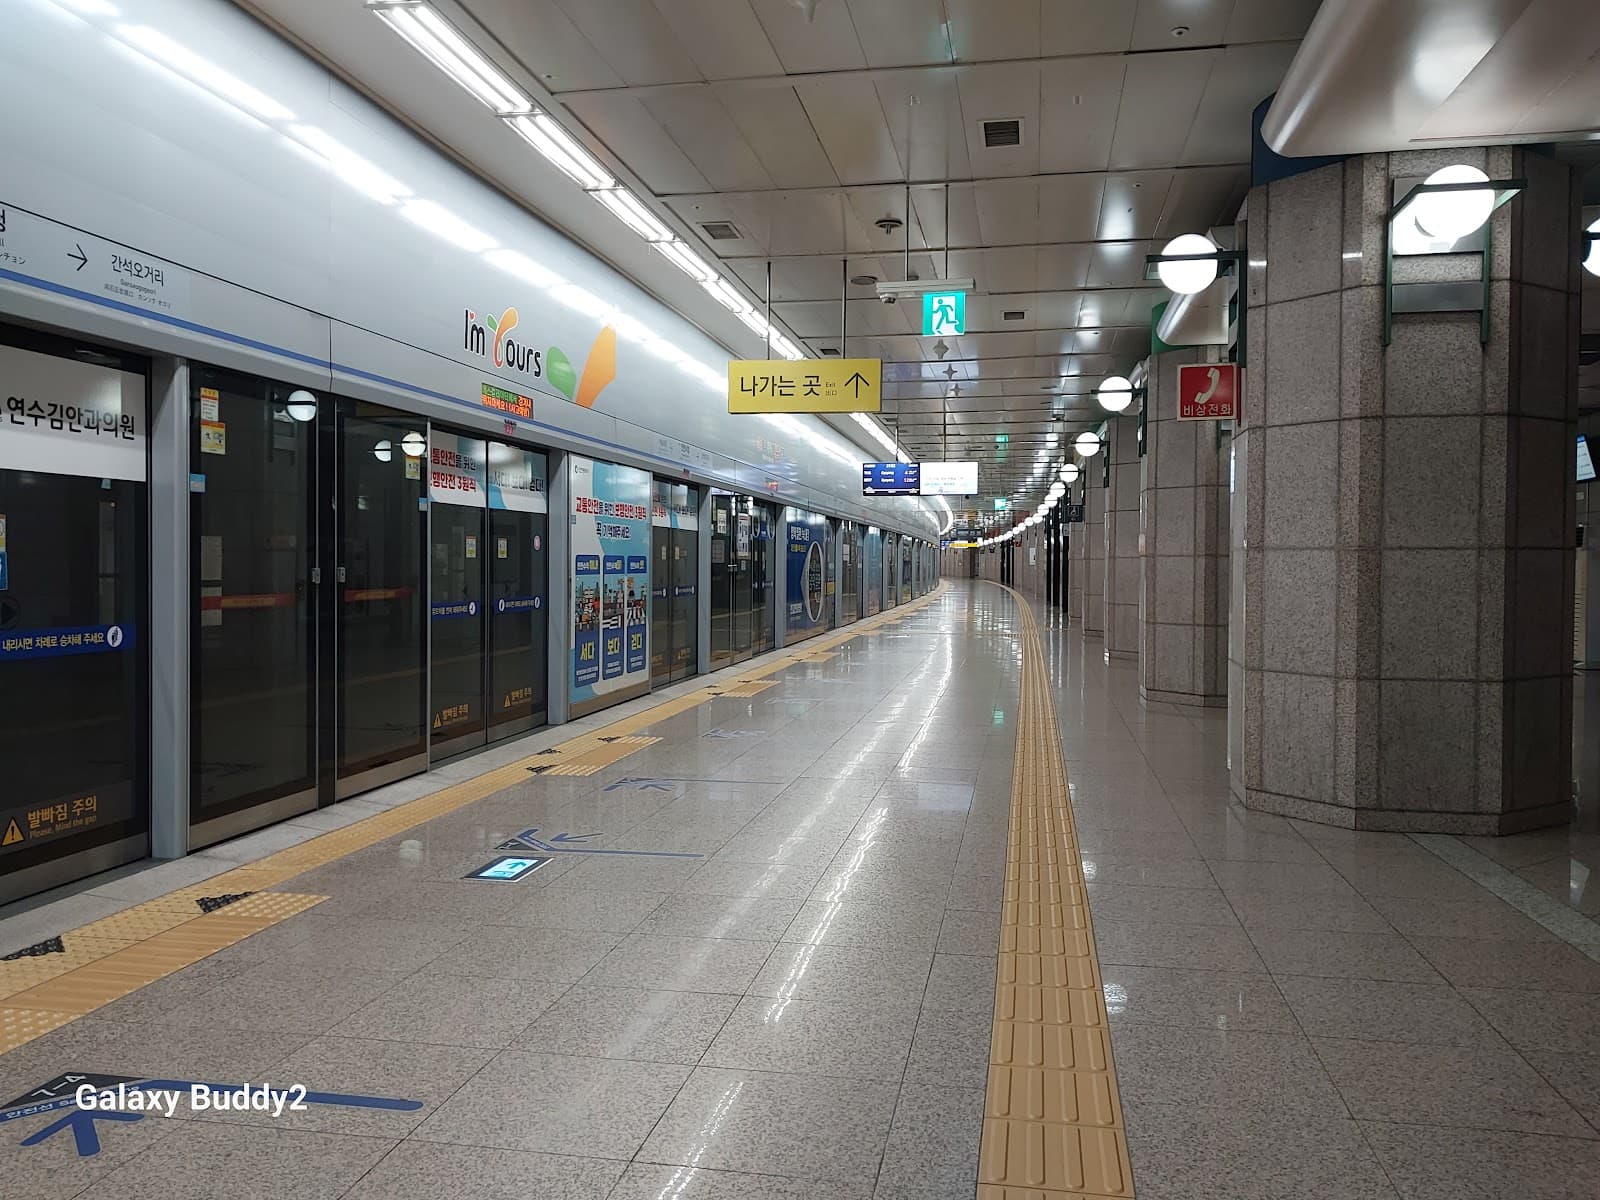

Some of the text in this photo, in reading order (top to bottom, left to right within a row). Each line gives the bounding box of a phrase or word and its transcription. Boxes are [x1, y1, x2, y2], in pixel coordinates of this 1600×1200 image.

[111, 254, 165, 287] 간석오거리
[487, 307, 542, 377] Yours
[740, 375, 821, 396] 나가는 곳
[7, 396, 135, 440] 연수김안과의원
[1183, 403, 1232, 416] 비상전화
[457, 474, 477, 493] 3원칙
[2, 631, 105, 652] 내리시면 차례로 승차해 주세요
[27, 795, 97, 829] 발빠짐 주의
